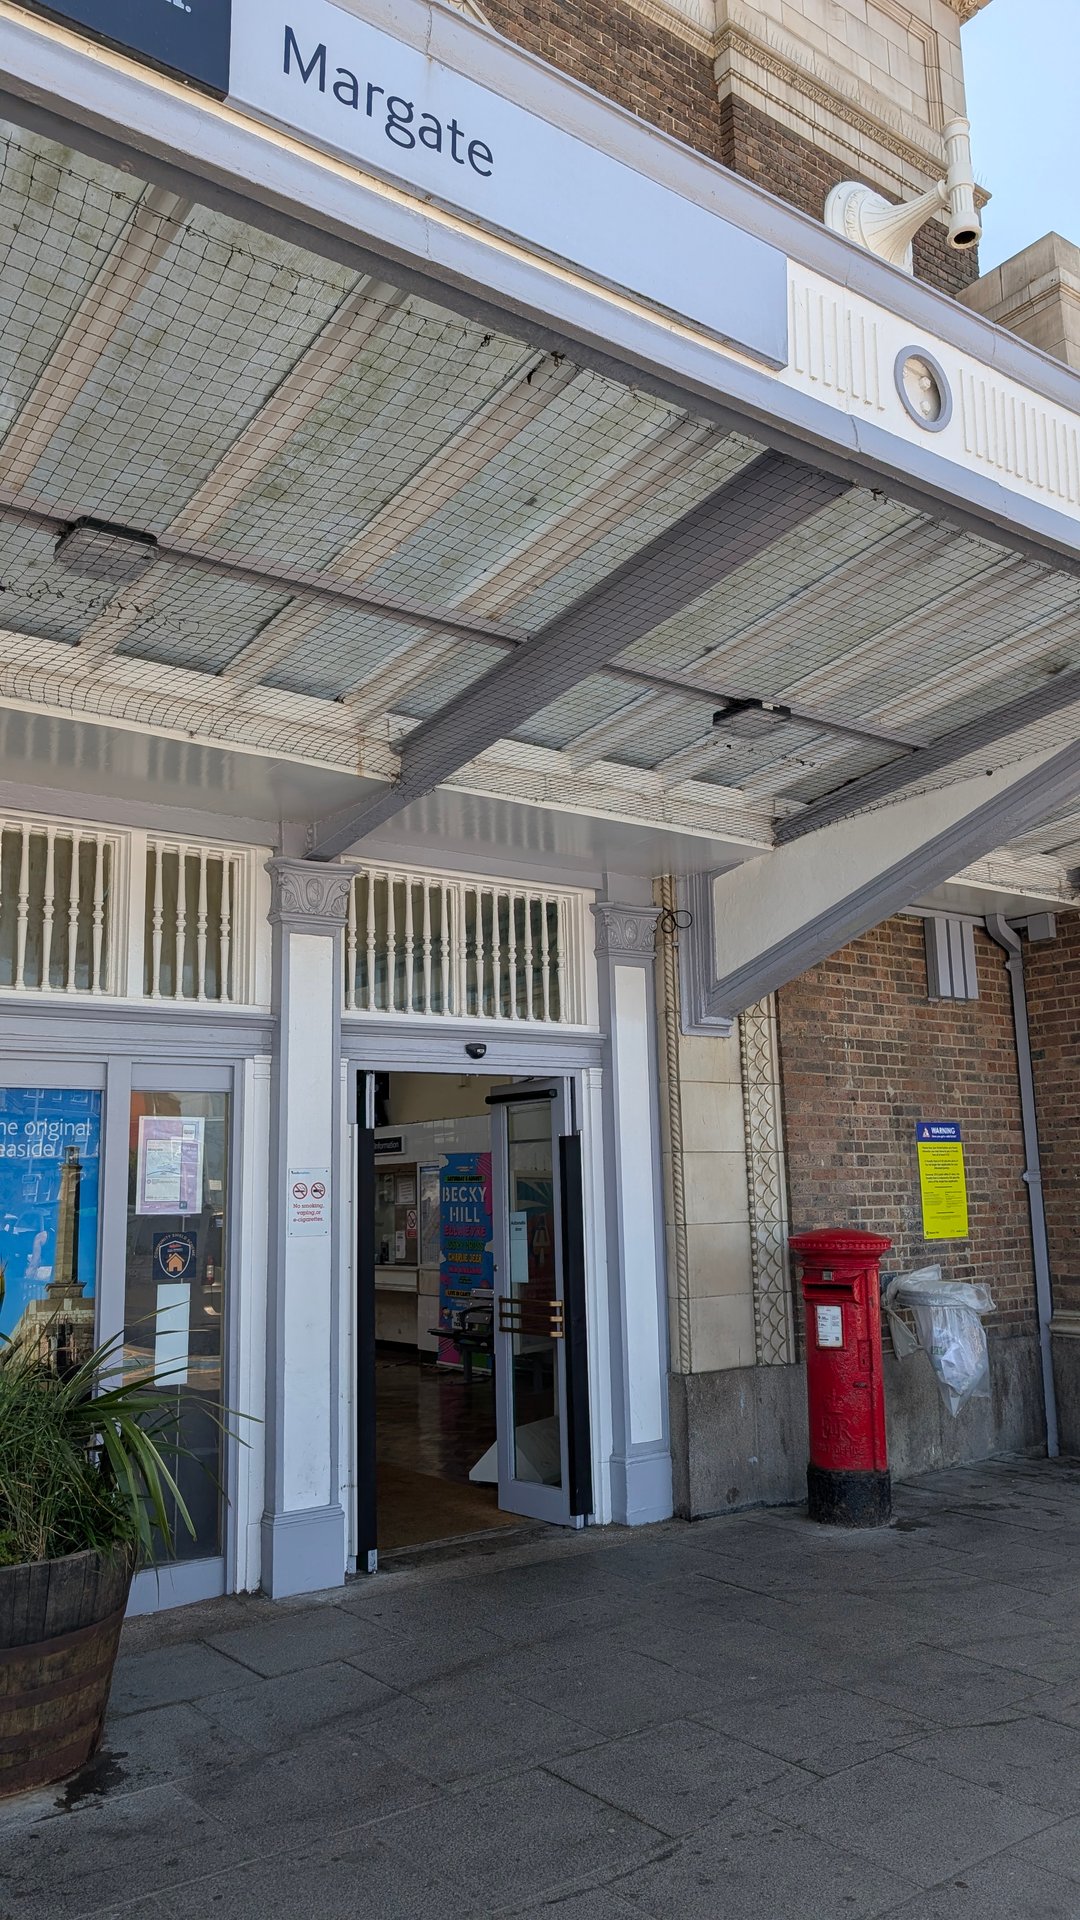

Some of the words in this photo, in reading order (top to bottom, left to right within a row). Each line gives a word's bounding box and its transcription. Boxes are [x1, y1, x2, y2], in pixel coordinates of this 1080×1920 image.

[283, 24, 494, 176] Margate
[24, 1117, 91, 1141] original
[442, 1186, 487, 1202] BECKY
[450, 1206, 480, 1222] HILL
